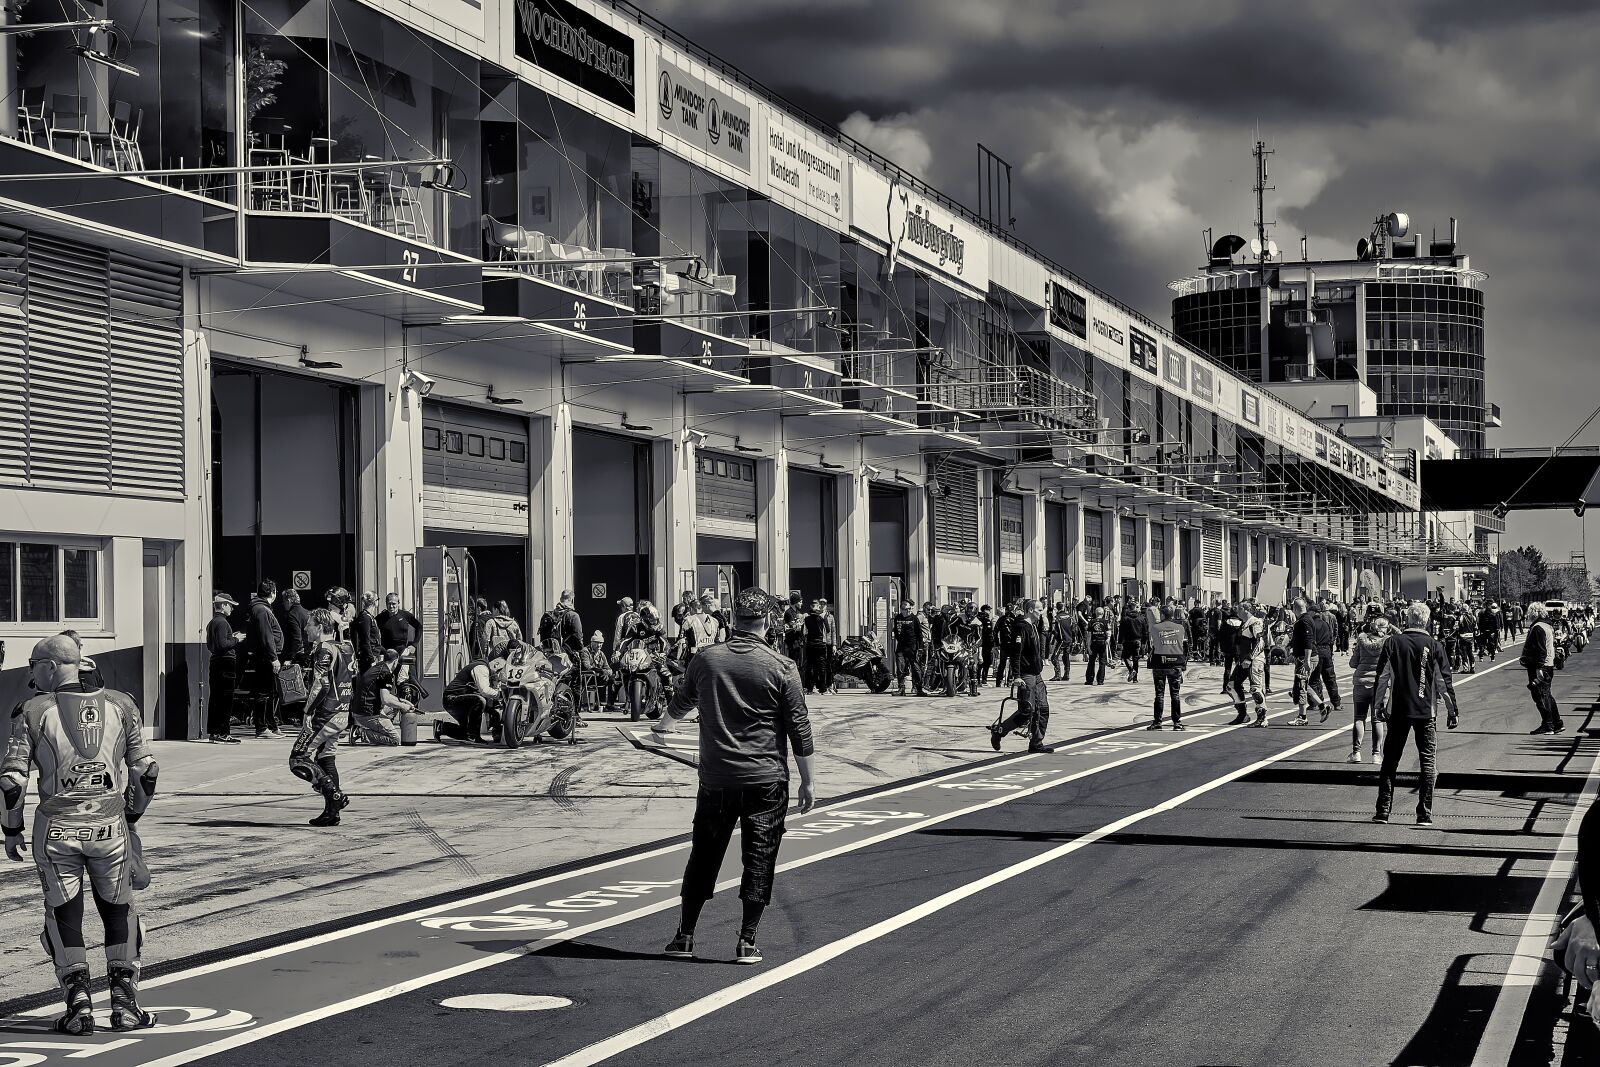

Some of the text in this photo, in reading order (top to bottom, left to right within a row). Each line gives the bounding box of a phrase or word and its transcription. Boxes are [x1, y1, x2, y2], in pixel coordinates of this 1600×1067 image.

[674, 83, 705, 114] MUNDORF
[682, 106, 698, 130] TANK
[721, 109, 750, 138] MUNDORF
[728, 131, 743, 153] TANK
[769, 126, 841, 184] Hotel und Kongresszentrum
[770, 155, 800, 189] Wanderath
[403, 249, 420, 283] 27
[573, 301, 587, 331] 26
[702, 340, 712, 366] 25
[804, 370, 813, 393] 24
[507, 669, 524, 680] 18
[96, 824, 114, 842] #1
